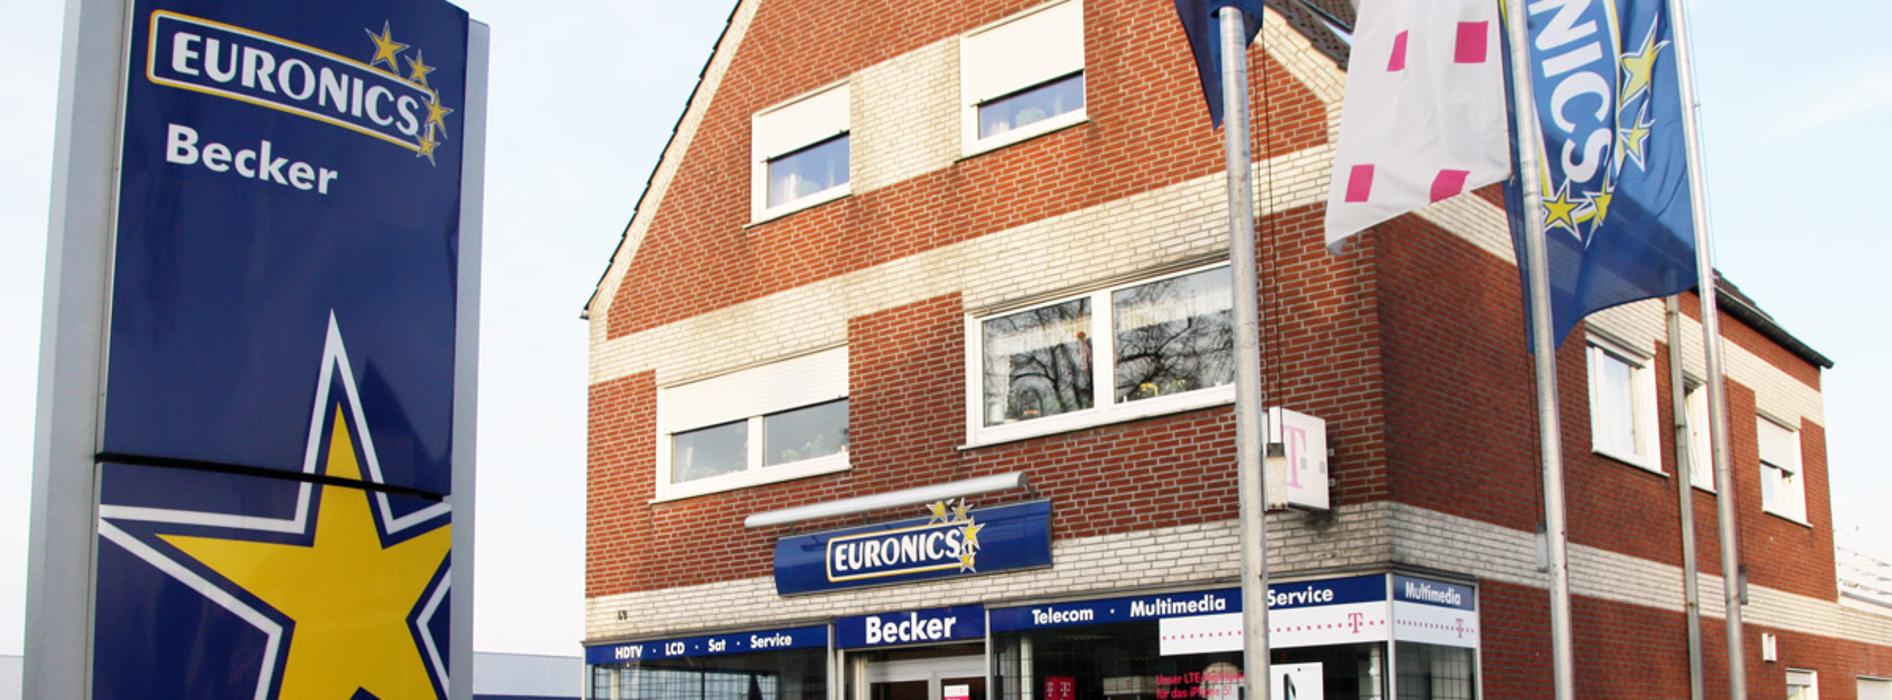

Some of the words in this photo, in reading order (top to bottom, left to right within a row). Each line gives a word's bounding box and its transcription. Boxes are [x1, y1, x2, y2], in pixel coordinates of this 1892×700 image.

[171, 31, 419, 136] EURONICS
[166, 123, 338, 195] Becker
[834, 529, 961, 571] EURONICS
[1032, 607, 1094, 625] Telecom
[1130, 594, 1226, 617] Multimedia
[1268, 585, 1334, 606] Service
[1405, 581, 1462, 605] Multimedia
[866, 611, 956, 644] Becker
[1347, 612, 1363, 634] T
[615, 645, 643, 659] HDTV
[665, 642, 685, 656] LCD
[708, 638, 726, 652] Sat
[750, 632, 792, 649] Service
